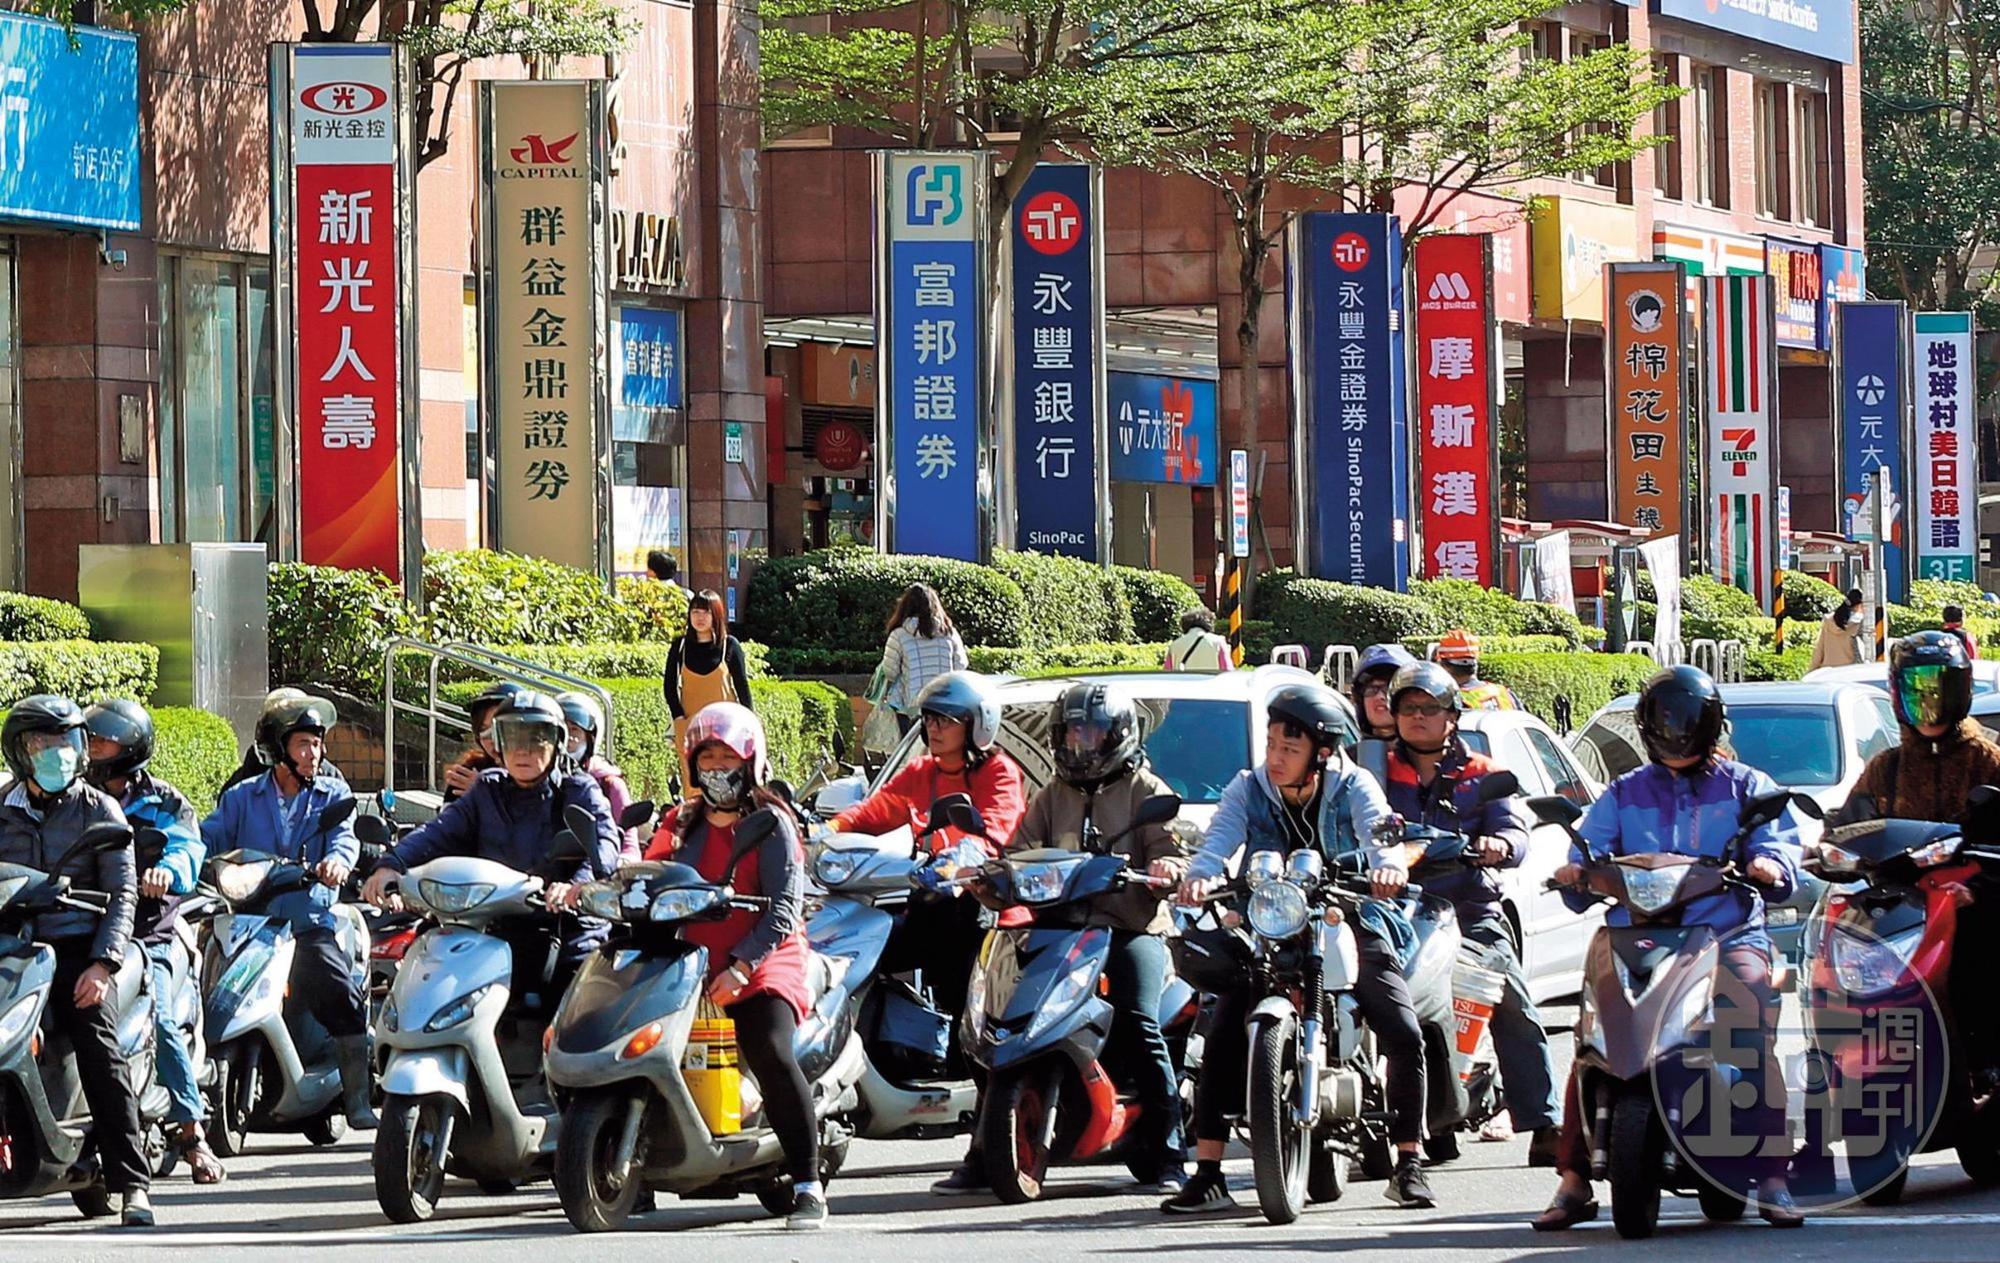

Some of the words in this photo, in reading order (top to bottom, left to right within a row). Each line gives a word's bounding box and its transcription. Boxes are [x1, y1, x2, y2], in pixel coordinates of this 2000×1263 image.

[302, 119, 386, 139] 新光金控
[332, 86, 356, 110] 光
[72, 144, 125, 184] 新店分行
[500, 167, 583, 179] CAPITAL
[609, 209, 684, 287] PLAZA
[318, 189, 376, 450] 新光人壽
[1420, 301, 1441, 310] MOS
[520, 206, 570, 501] 群益金鼎證券
[913, 261, 957, 480] 富邦證券
[1032, 273, 1076, 479] 永豐銀行
[1338, 281, 1367, 432] 永豐金證券
[1137, 409, 1184, 451] 元大銀行
[1429, 336, 1479, 582] 摩斯漢堡
[1625, 342, 1669, 532] 棉花田生機
[1927, 341, 1961, 548] 地球村美日韓語
[1347, 437, 1364, 507] SinoPac
[1028, 531, 1086, 545] SinoPac
[1928, 559, 1963, 580] 3F
